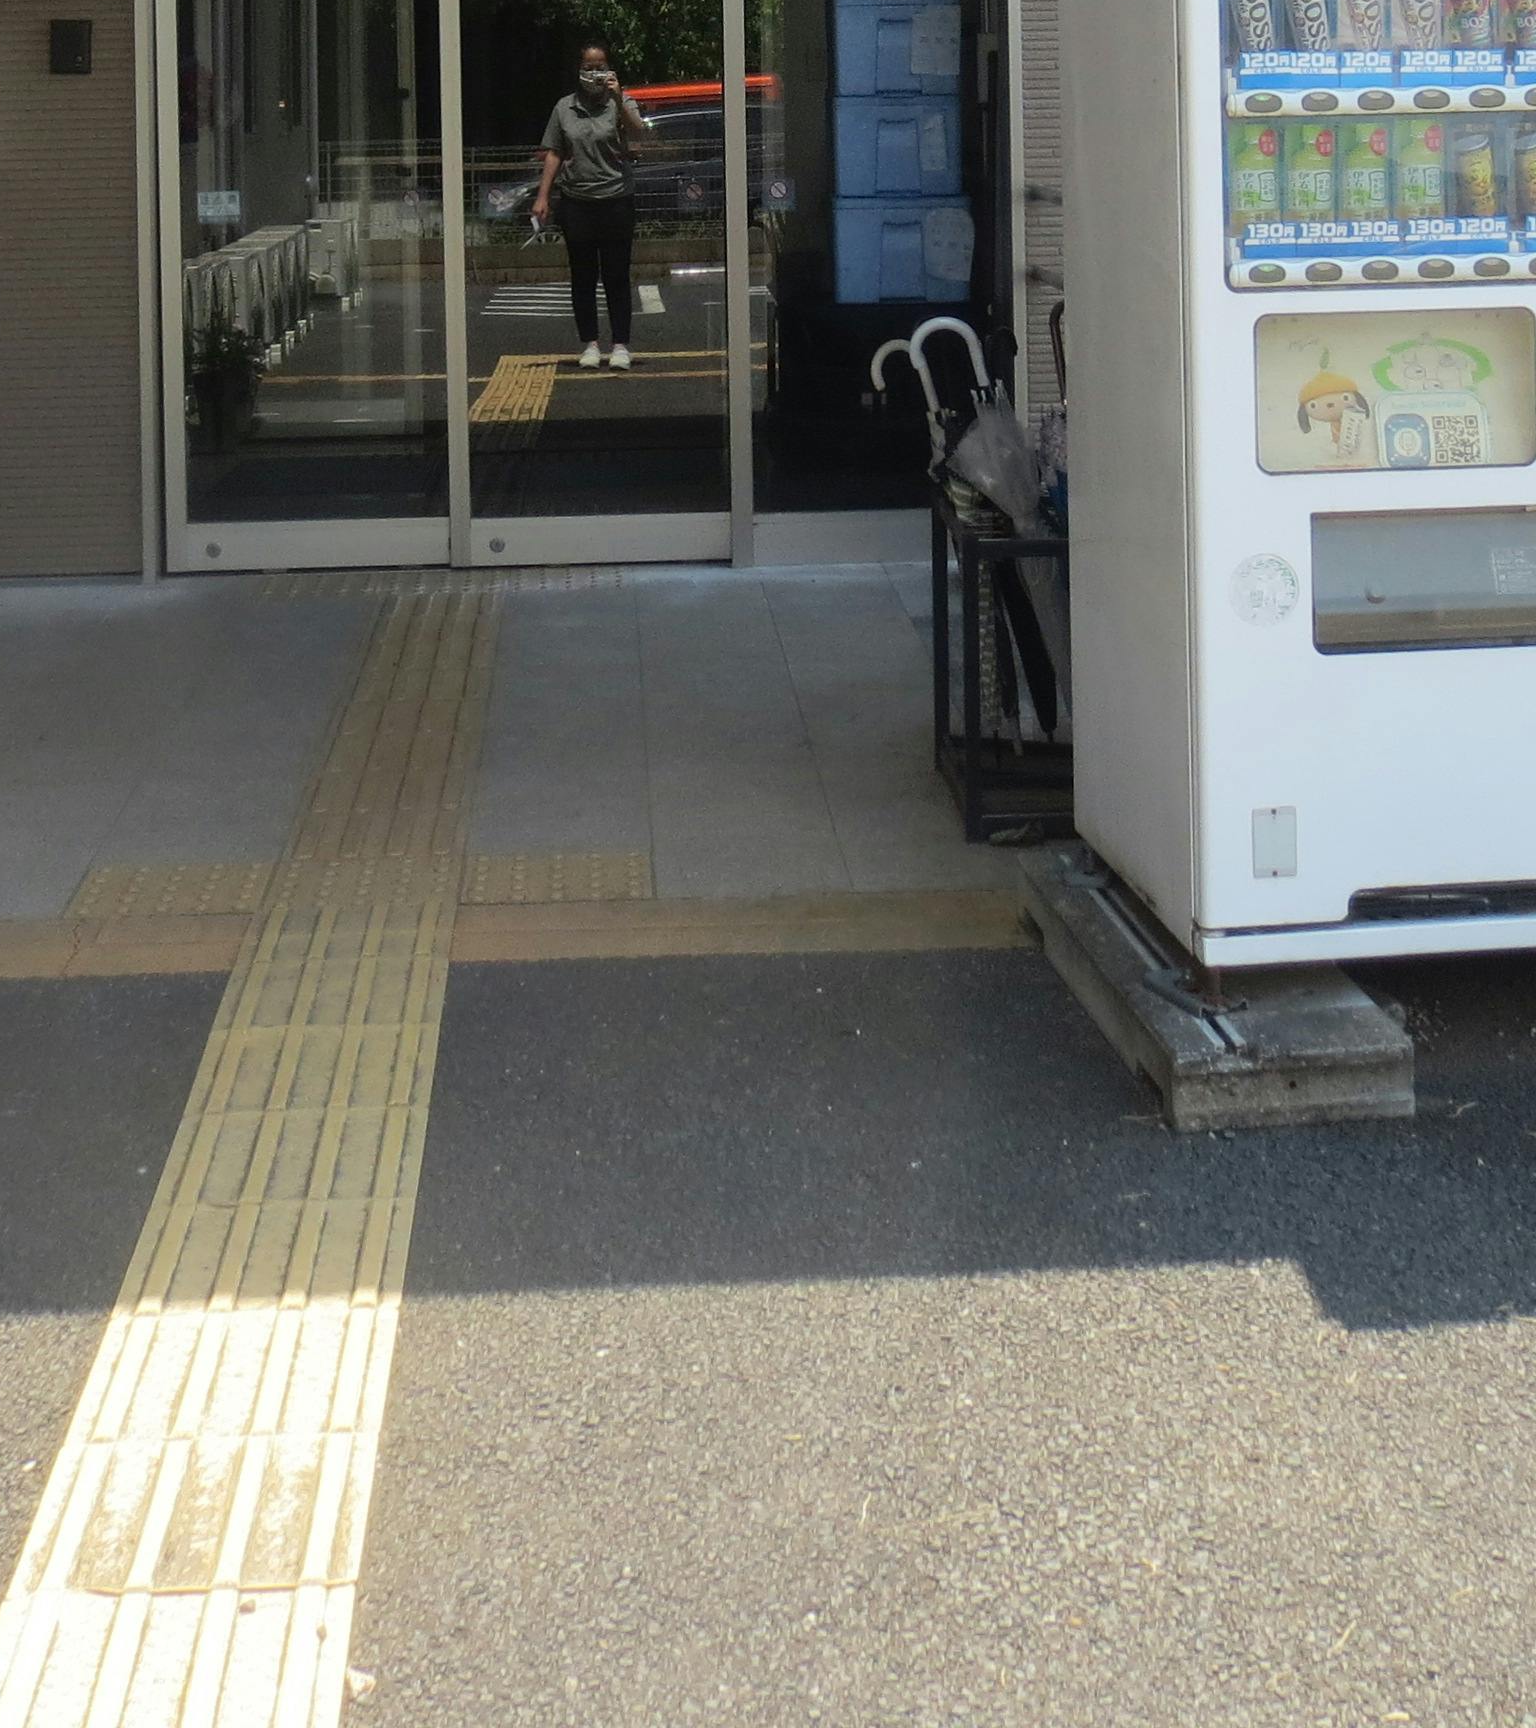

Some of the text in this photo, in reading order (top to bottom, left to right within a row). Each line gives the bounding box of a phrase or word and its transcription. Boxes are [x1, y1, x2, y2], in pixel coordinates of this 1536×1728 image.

[1242, 52, 1289, 68] 120円
[1291, 52, 1337, 67] 120円
[1343, 51, 1391, 66] 120円
[1404, 51, 1451, 66] 120円
[1455, 50, 1503, 65] 120円
[1248, 223, 1295, 238] 130円
[1300, 222, 1348, 237] 130円
[1351, 221, 1399, 236] 130円
[1408, 219, 1455, 234] 130円
[1459, 218, 1506, 233] 120円
